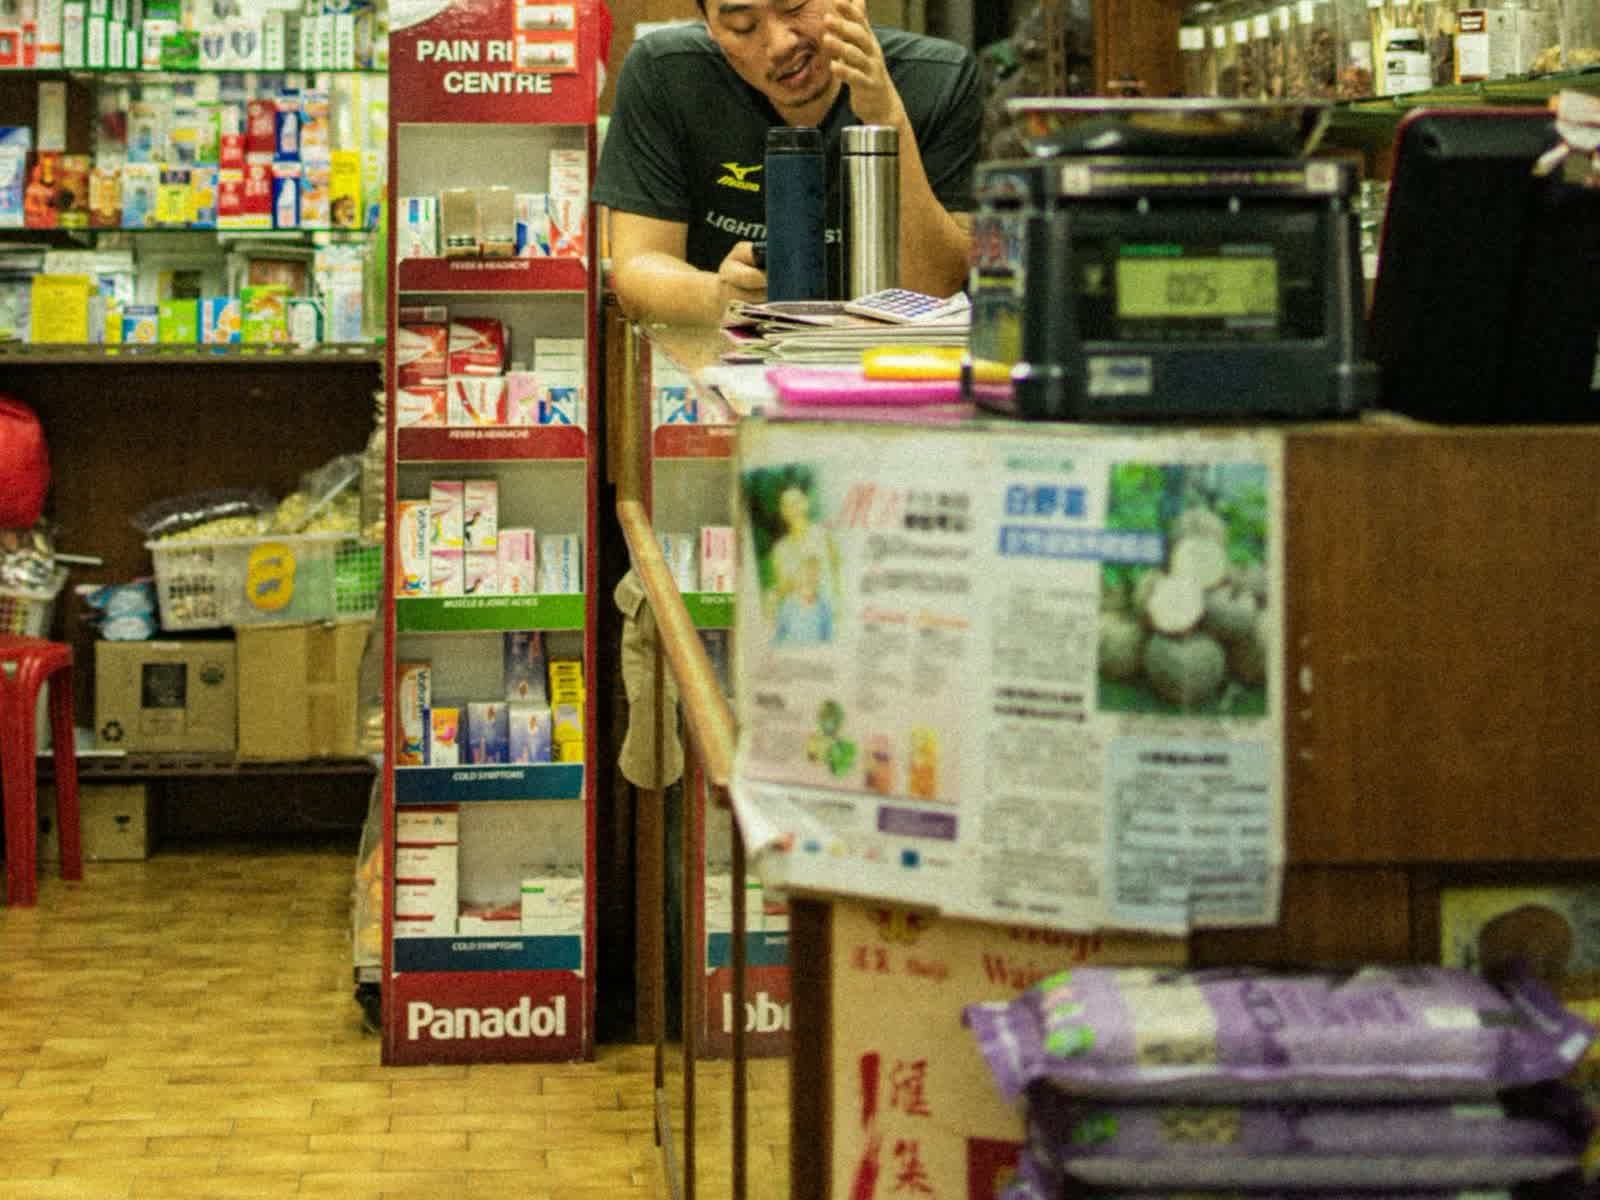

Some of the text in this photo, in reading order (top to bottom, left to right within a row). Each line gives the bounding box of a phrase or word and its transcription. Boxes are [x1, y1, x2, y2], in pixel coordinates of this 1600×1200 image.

[416, 40, 480, 62] PAIN
[443, 72, 553, 94] CENTRE
[407, 996, 567, 1041] Panadol
